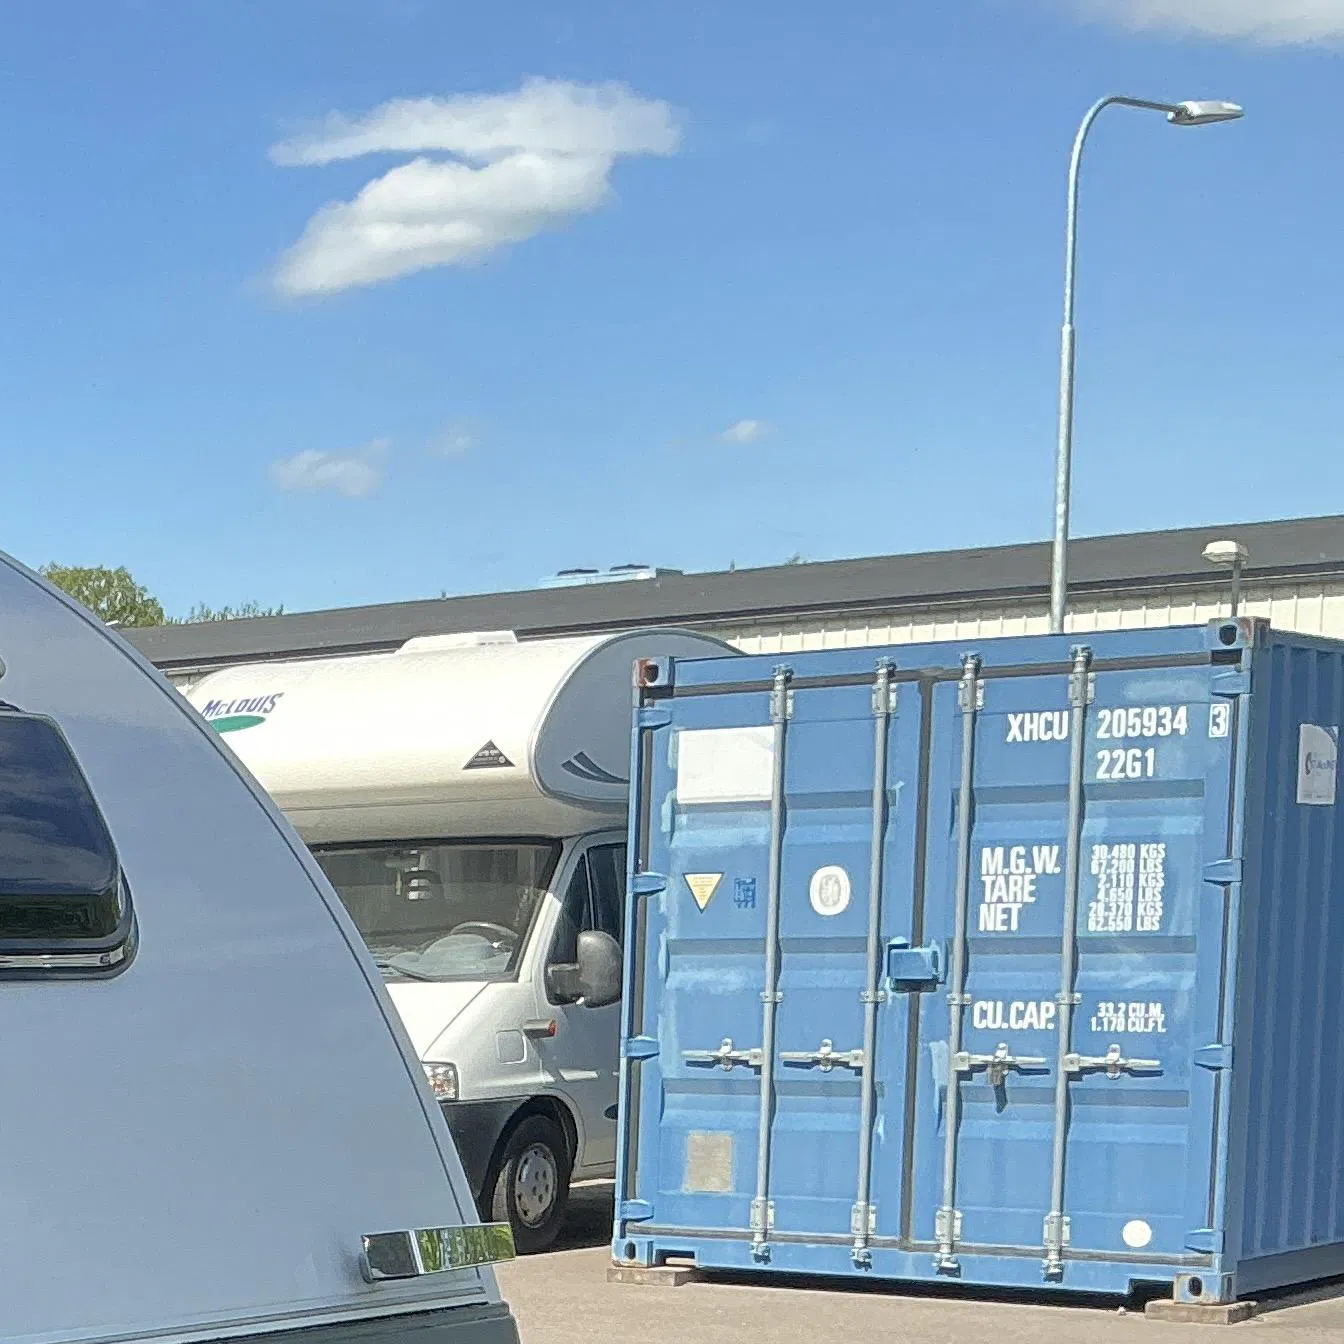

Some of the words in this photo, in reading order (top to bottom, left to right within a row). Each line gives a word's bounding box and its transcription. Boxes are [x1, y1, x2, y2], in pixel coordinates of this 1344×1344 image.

[1006, 711, 1069, 742] XHCU
[1096, 706, 1188, 739] 205934
[1210, 706, 1227, 737] 3
[1096, 748, 1155, 779] 22G1
[981, 846, 1061, 874] M.G.W.
[1140, 843, 1166, 858] KGS
[981, 874, 1036, 903] TARE
[1139, 872, 1165, 887] KGS
[979, 903, 1023, 931] NET
[1137, 902, 1163, 916] KGS
[973, 1001, 1055, 1030] CU.CAP.
